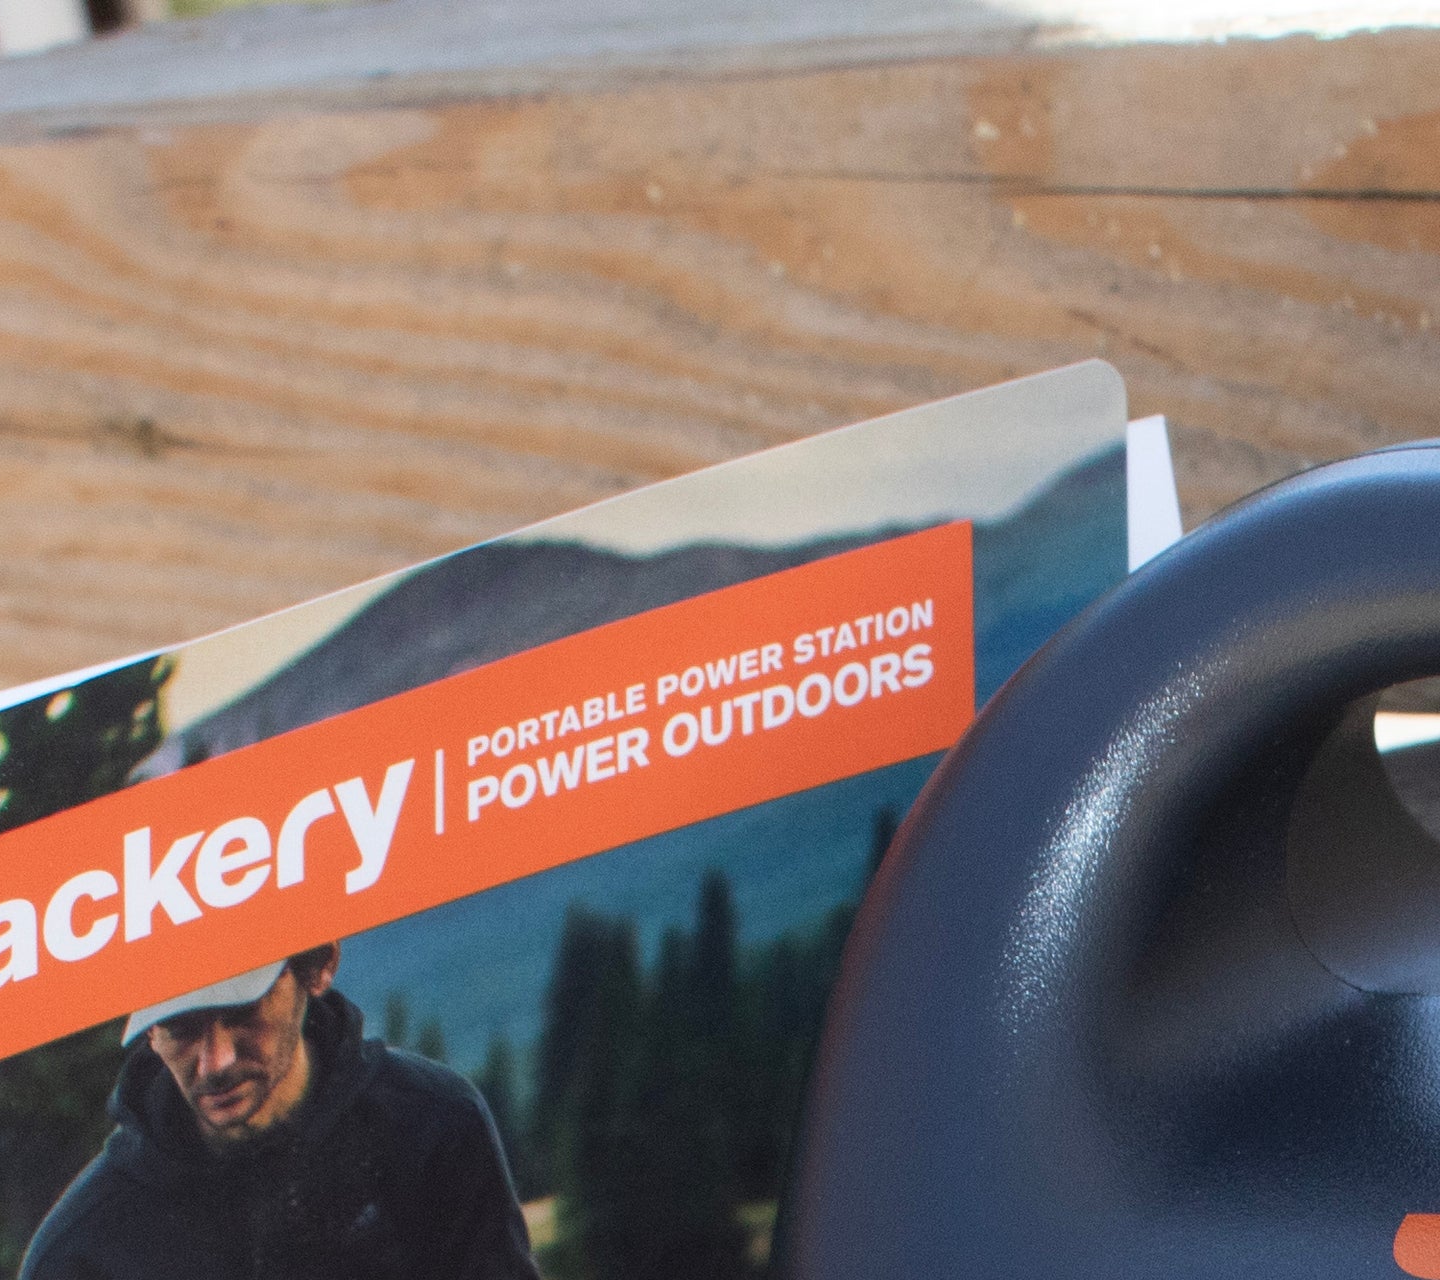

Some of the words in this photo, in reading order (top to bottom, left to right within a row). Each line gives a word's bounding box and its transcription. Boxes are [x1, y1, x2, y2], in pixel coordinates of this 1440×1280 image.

[466, 683, 647, 767] PORTABLE
[656, 642, 783, 706] POWER
[792, 598, 934, 664] STATION
[467, 727, 650, 823] POWER
[662, 643, 934, 758] OUTDOORS
